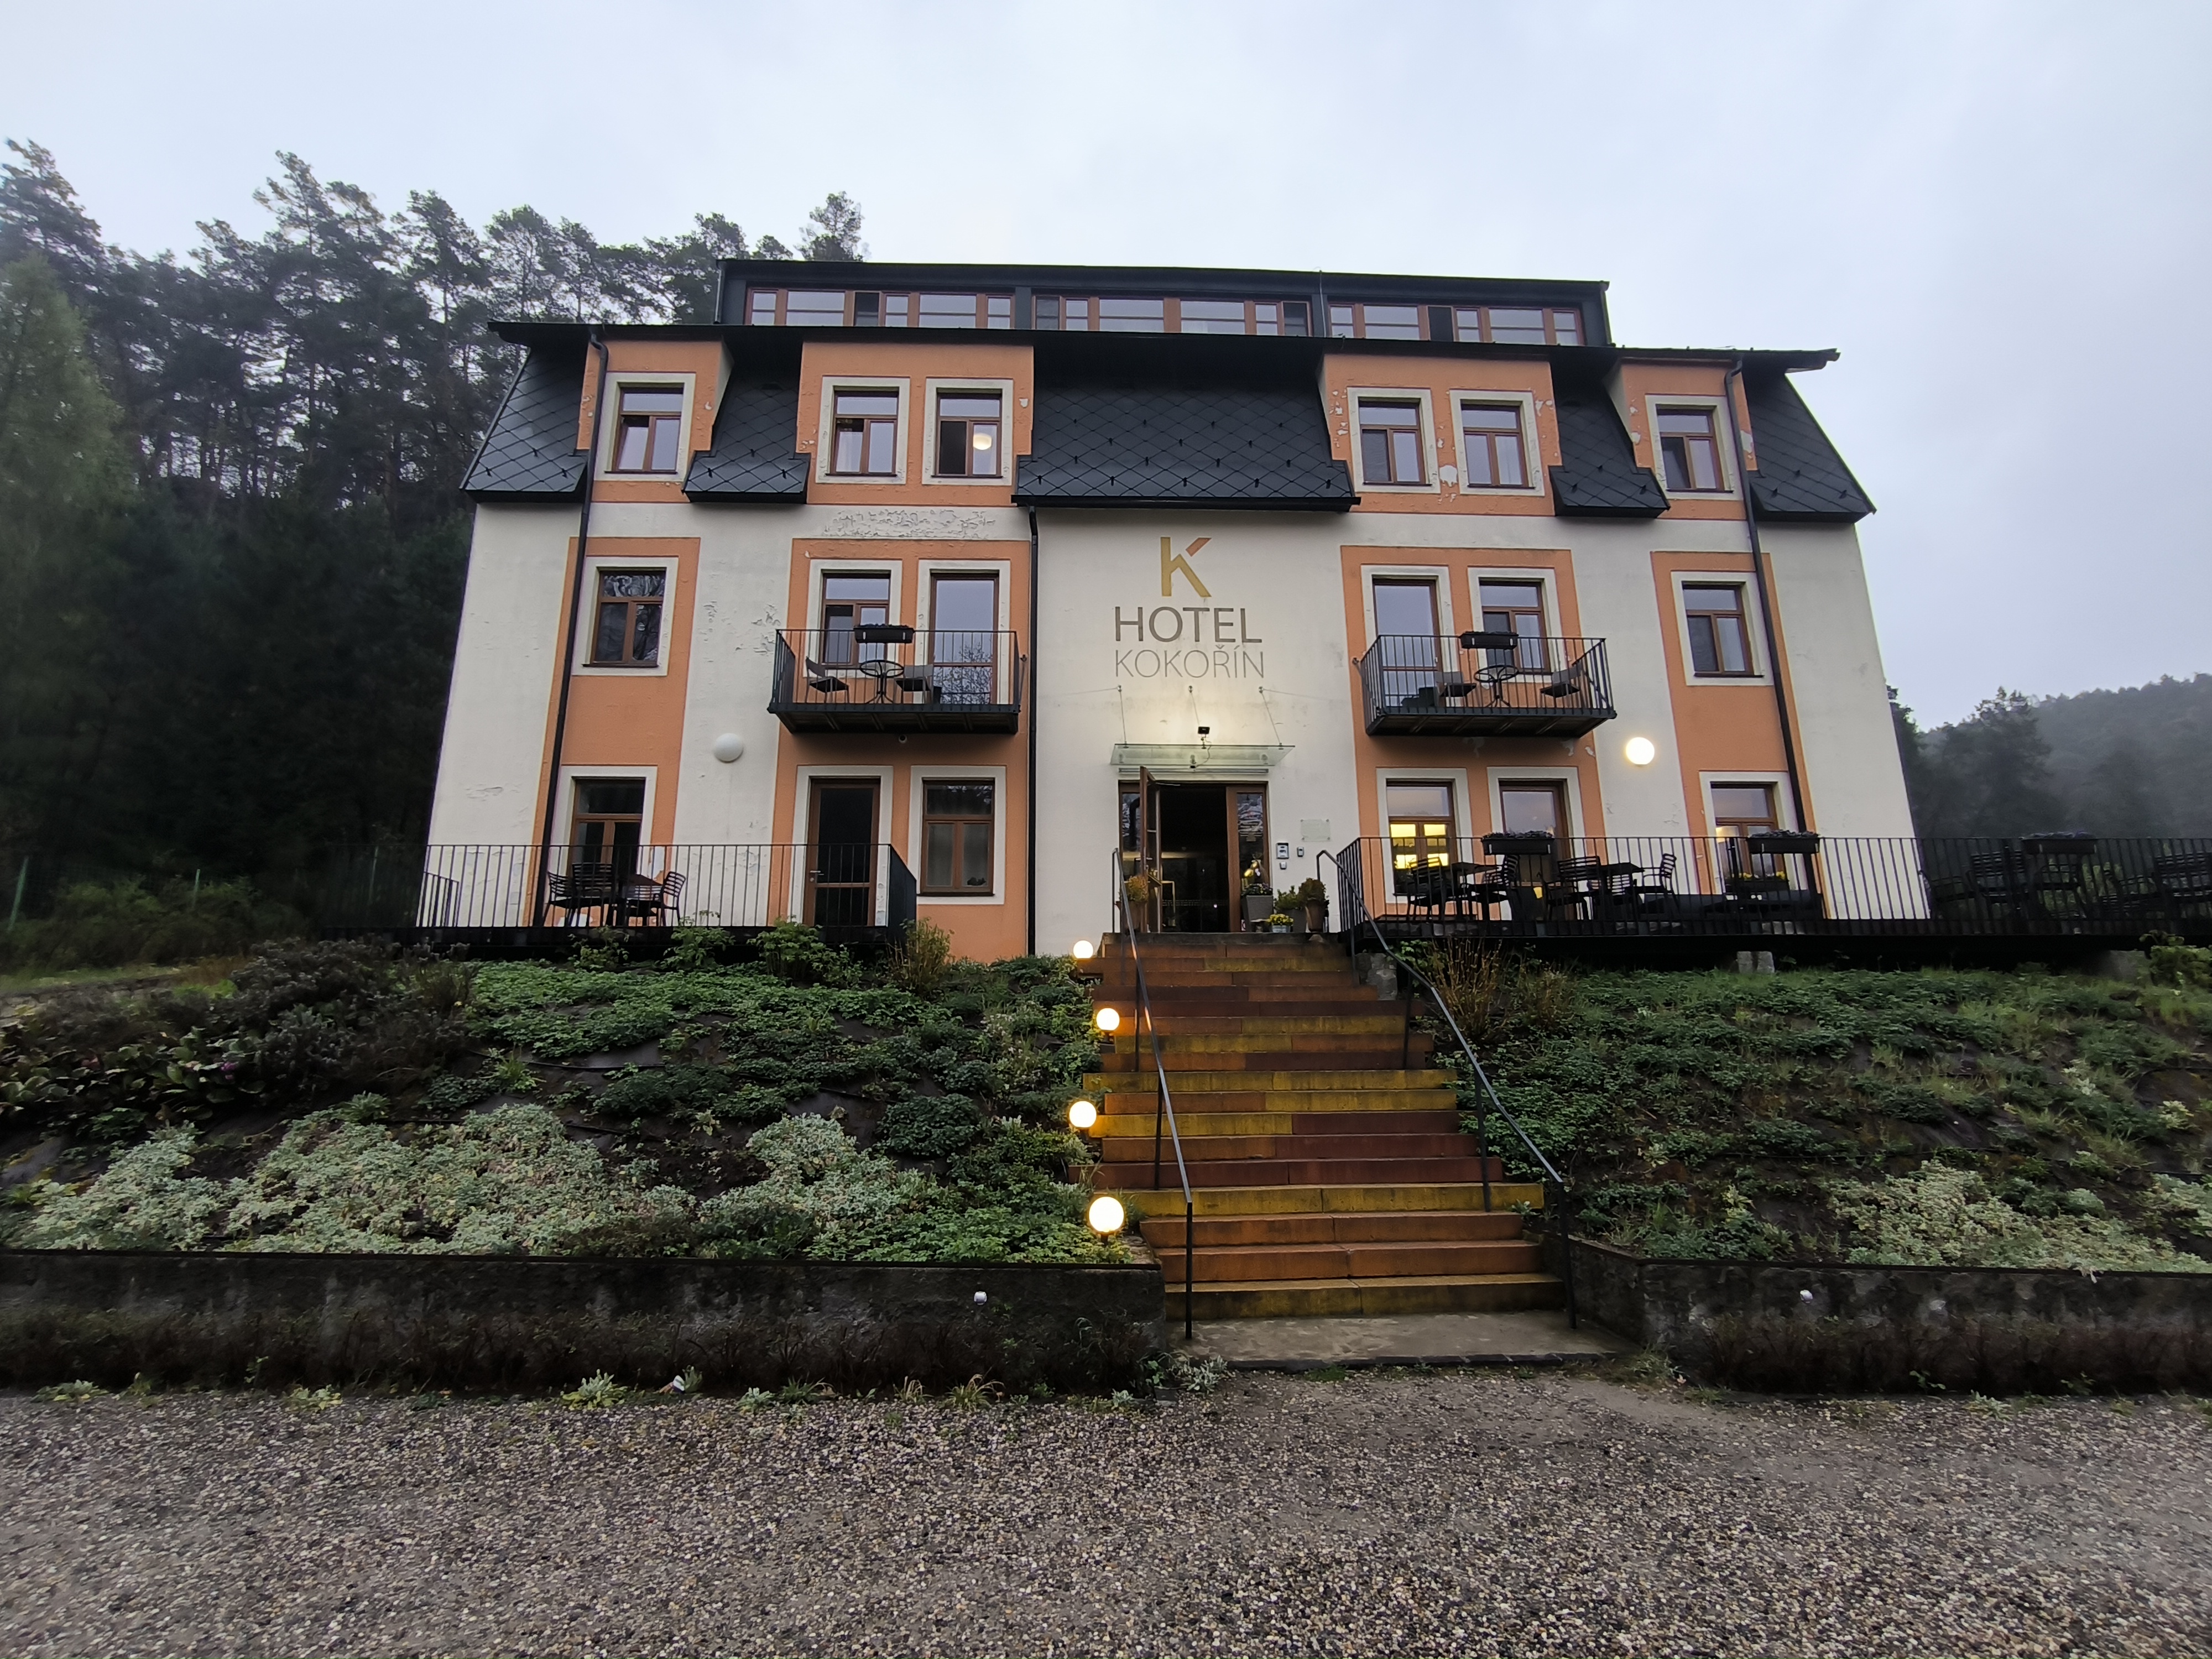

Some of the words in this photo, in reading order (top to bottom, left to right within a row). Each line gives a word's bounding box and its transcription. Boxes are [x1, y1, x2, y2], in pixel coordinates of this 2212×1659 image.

[1160, 536, 1212, 597] K
[1115, 606, 1262, 643] HOTEL
[1115, 645, 1264, 679] KOKOŘÍN
